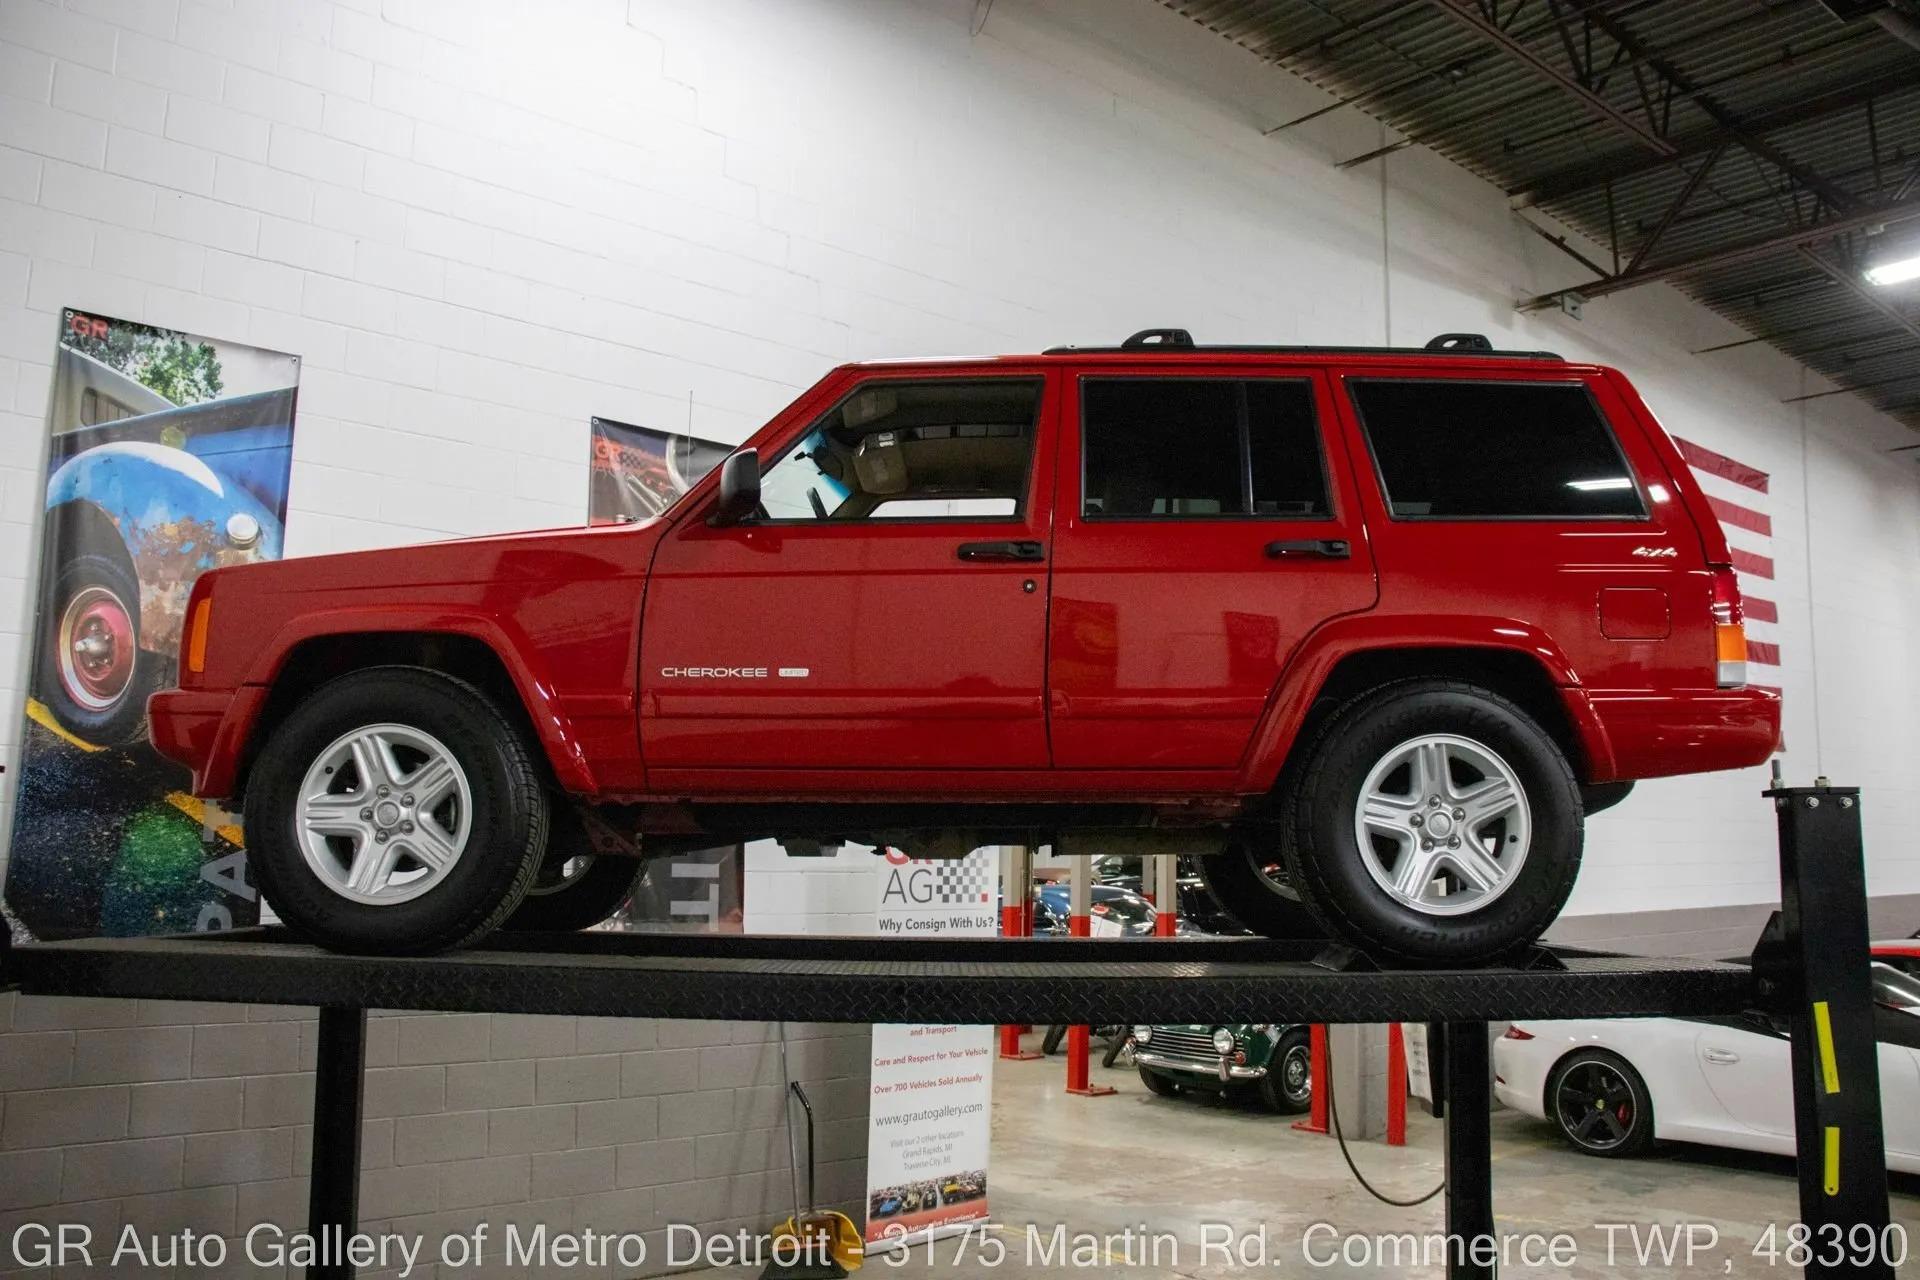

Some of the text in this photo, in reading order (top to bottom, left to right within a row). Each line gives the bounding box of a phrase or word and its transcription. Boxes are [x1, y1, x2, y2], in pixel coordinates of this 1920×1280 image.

[71, 314, 108, 340] GR
[661, 667, 768, 678] CHEROKEE
[882, 868, 932, 904] AG
[879, 916, 994, 933] Why Consign With Us?
[910, 1025, 957, 1036] and Transport
[874, 1058, 890, 1067] Care
[893, 1055, 906, 1065] and
[908, 1052, 935, 1064] Respect
[936, 1052, 947, 1061] for
[948, 1050, 963, 1059] Your
[874, 1072, 983, 1094] Over 700 Vehicles Sold Annually
[875, 1103, 983, 1127] www.grautogallery.com
